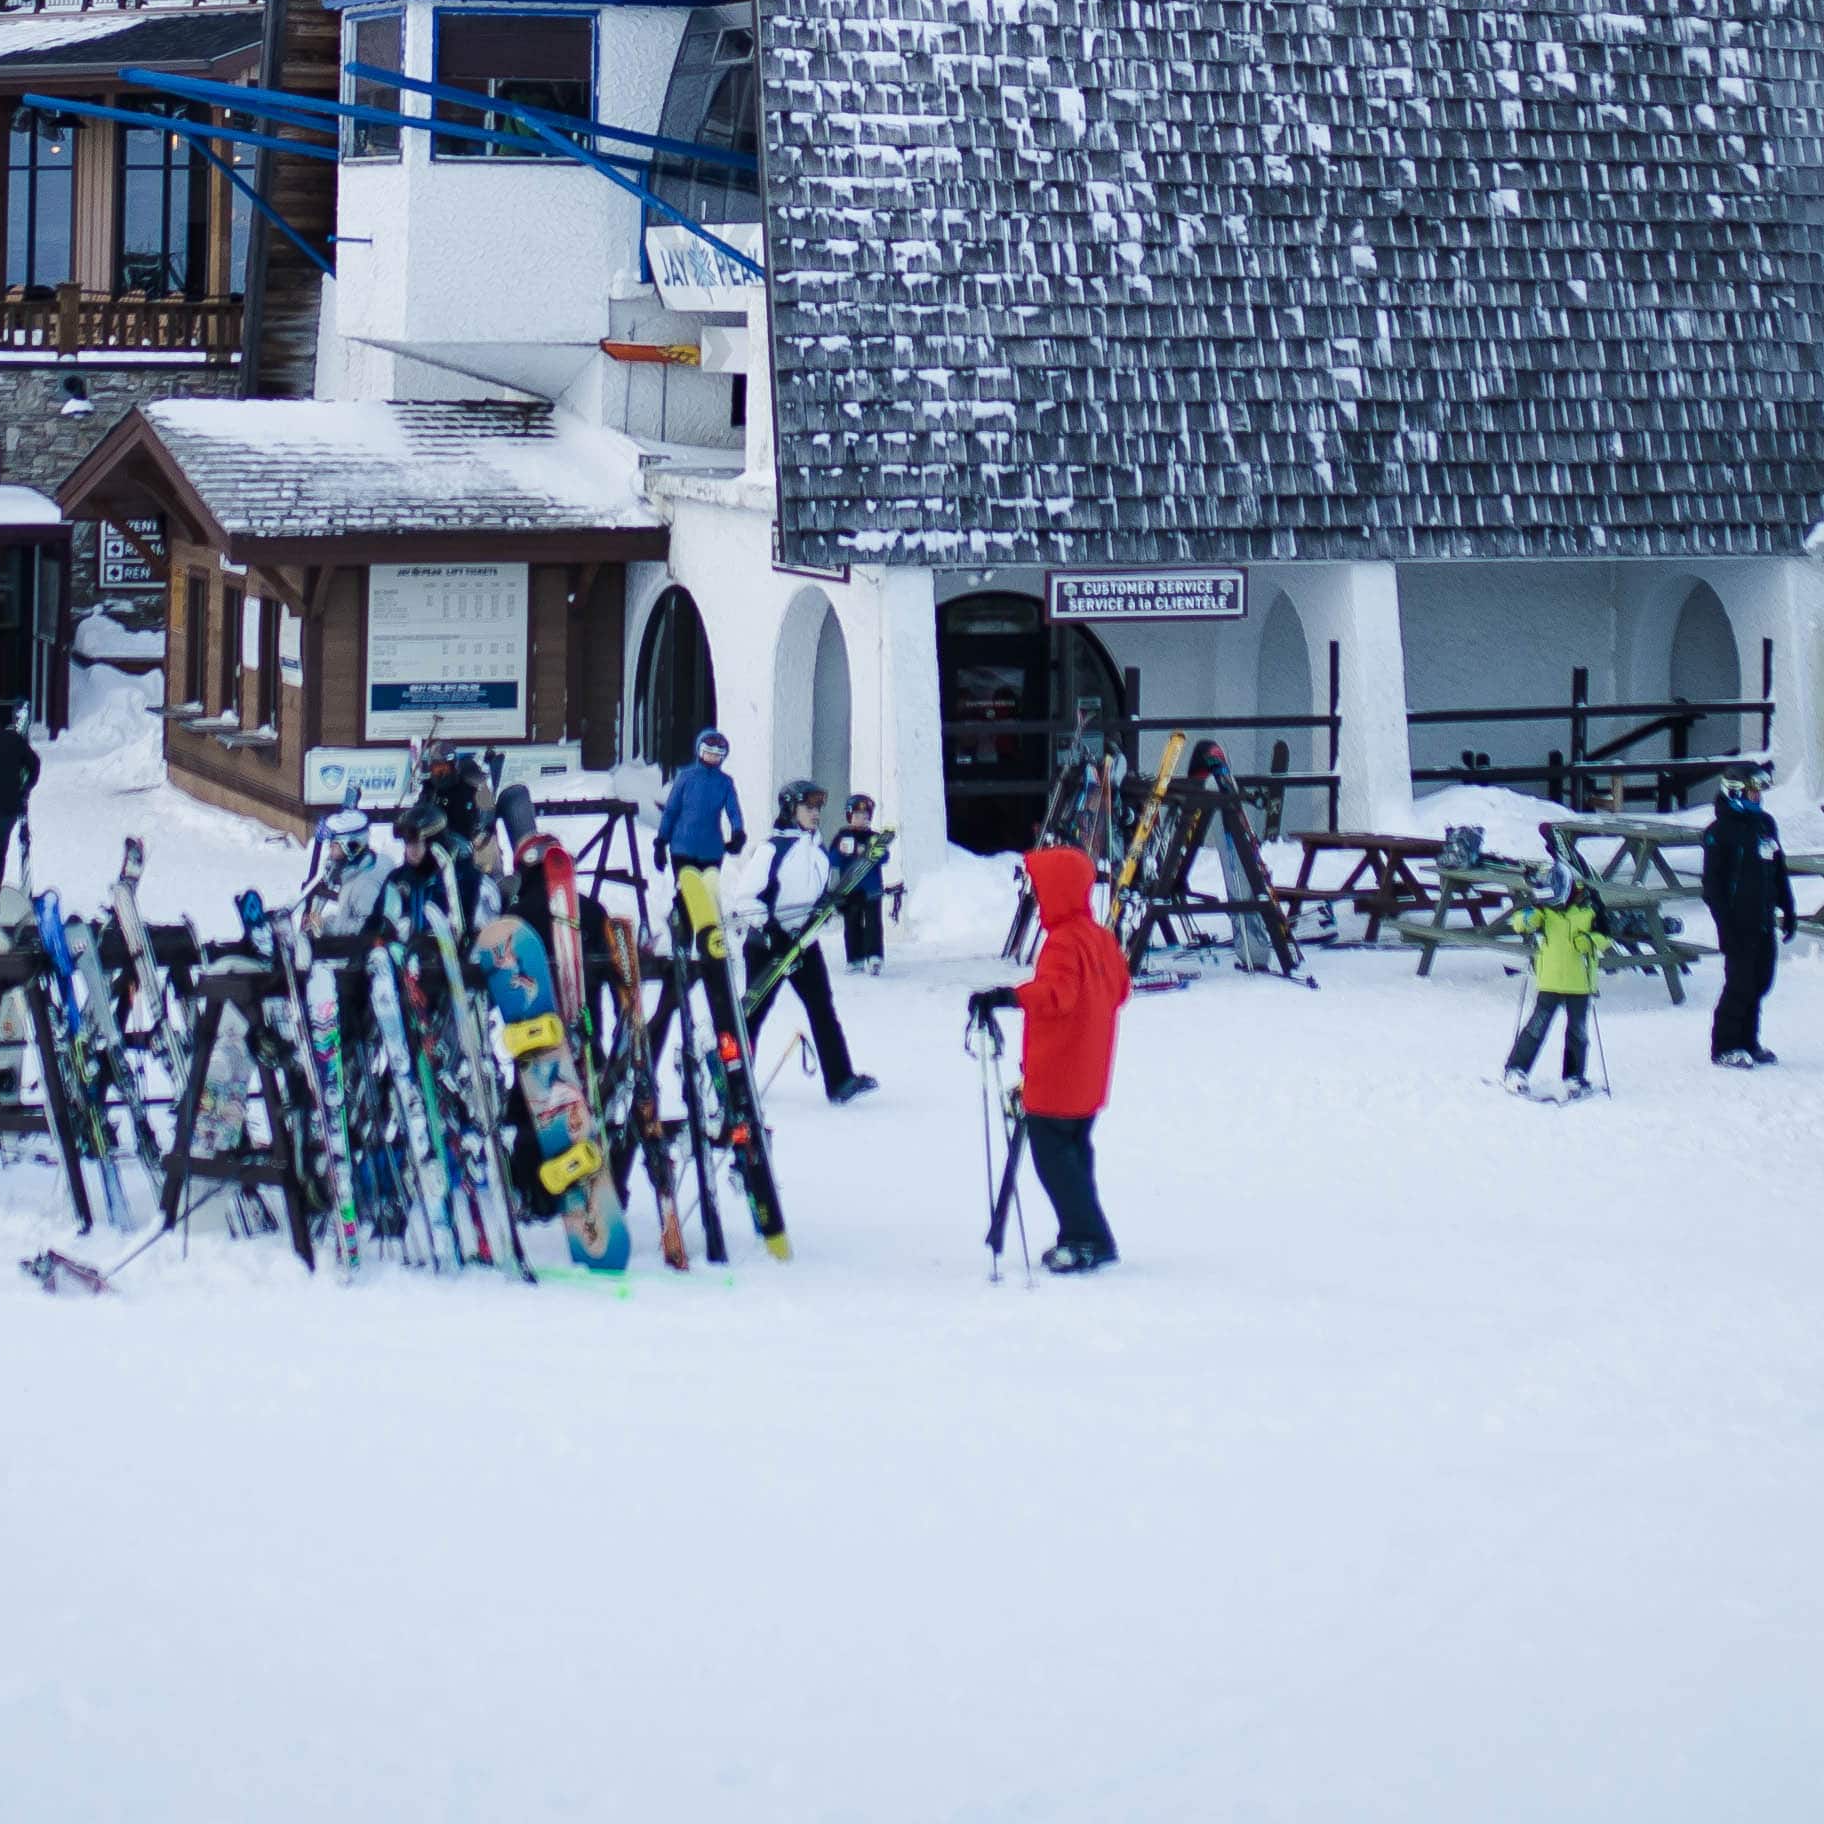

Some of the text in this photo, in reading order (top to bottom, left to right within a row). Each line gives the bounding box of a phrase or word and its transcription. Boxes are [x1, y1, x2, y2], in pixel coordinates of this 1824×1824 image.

[661, 250, 689, 286] JAY
[1083, 580, 1213, 596] CUSTOMER SERVICE
[1069, 593, 1227, 611] SERVICE à la CLIENTÈLE
